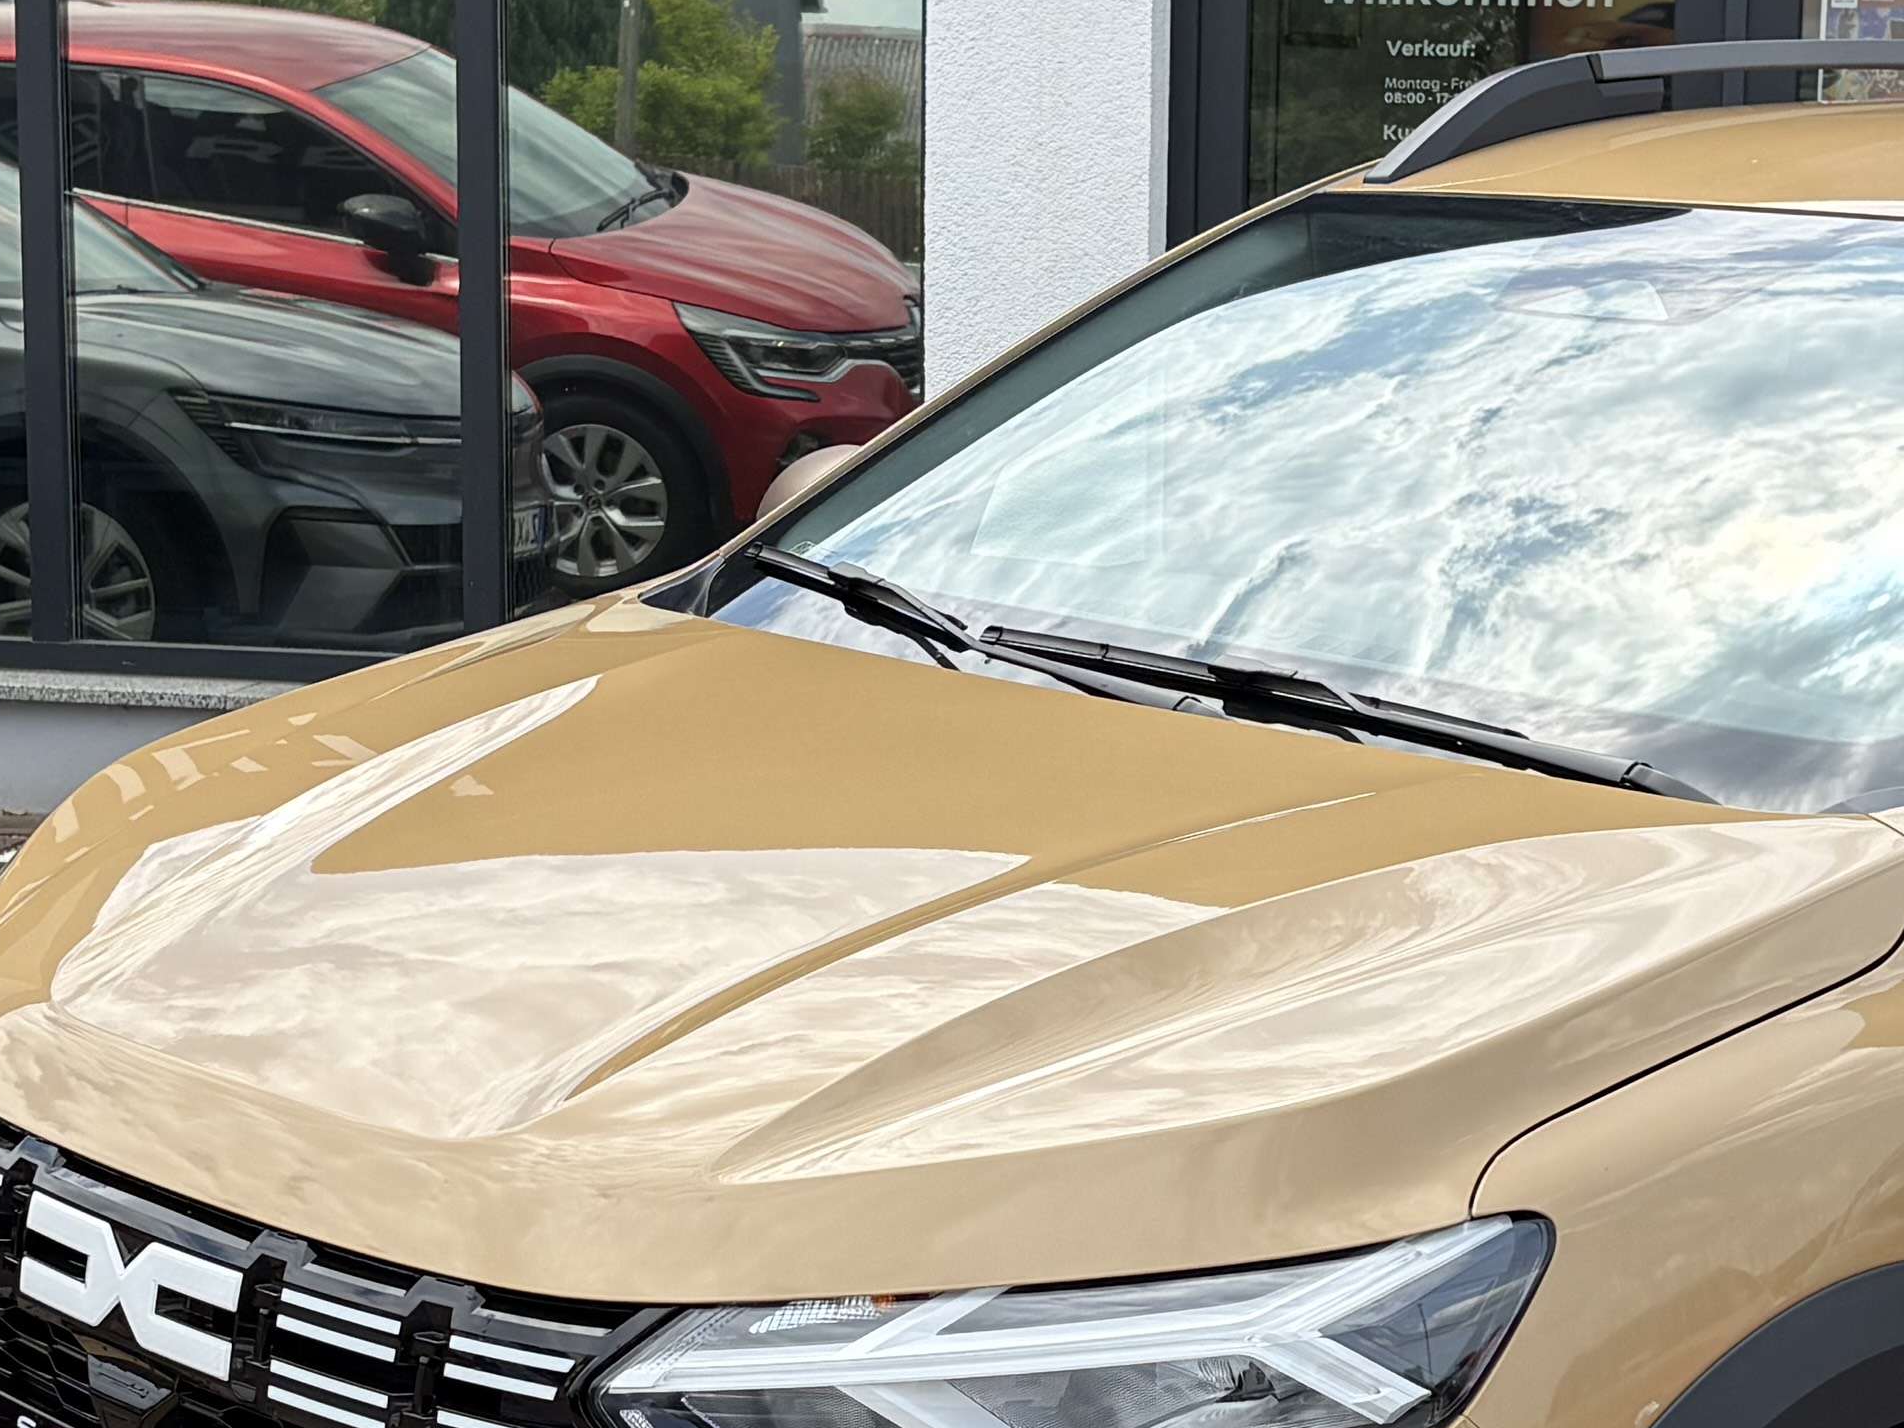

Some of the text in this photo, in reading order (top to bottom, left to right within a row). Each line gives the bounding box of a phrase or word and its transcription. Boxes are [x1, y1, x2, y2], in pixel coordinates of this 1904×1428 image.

[1386, 39, 1476, 58] Verkauf:
[1384, 77, 1441, 93] Montag
[1451, 77, 1480, 90] Fre
[1384, 92, 1425, 104] 08:00
[1383, 124, 1415, 141] Ku
